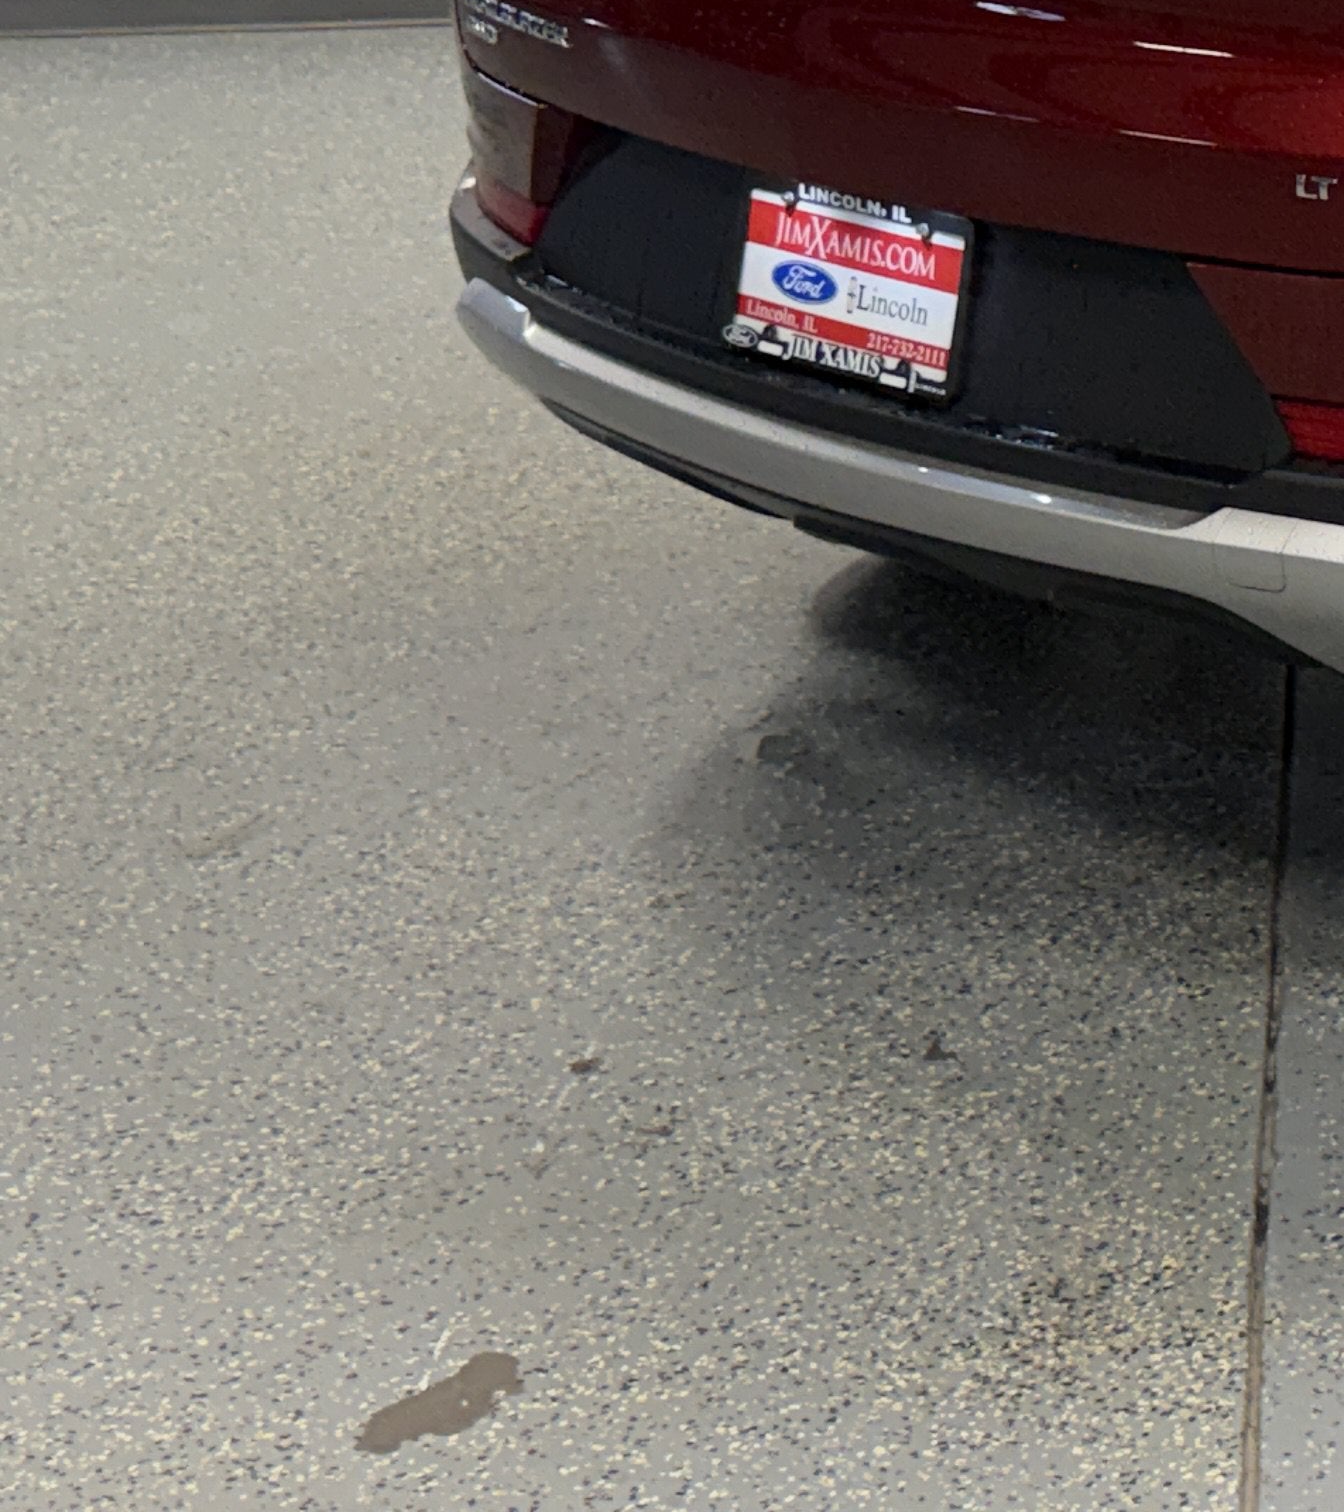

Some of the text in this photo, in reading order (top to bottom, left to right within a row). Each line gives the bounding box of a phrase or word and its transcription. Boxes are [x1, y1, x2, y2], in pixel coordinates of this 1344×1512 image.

[1295, 173, 1338, 201] LT
[891, 204, 912, 224] IL
[856, 284, 929, 326] Lincoln
[781, 335, 819, 361] JIM
[819, 341, 881, 379] XAMIS
